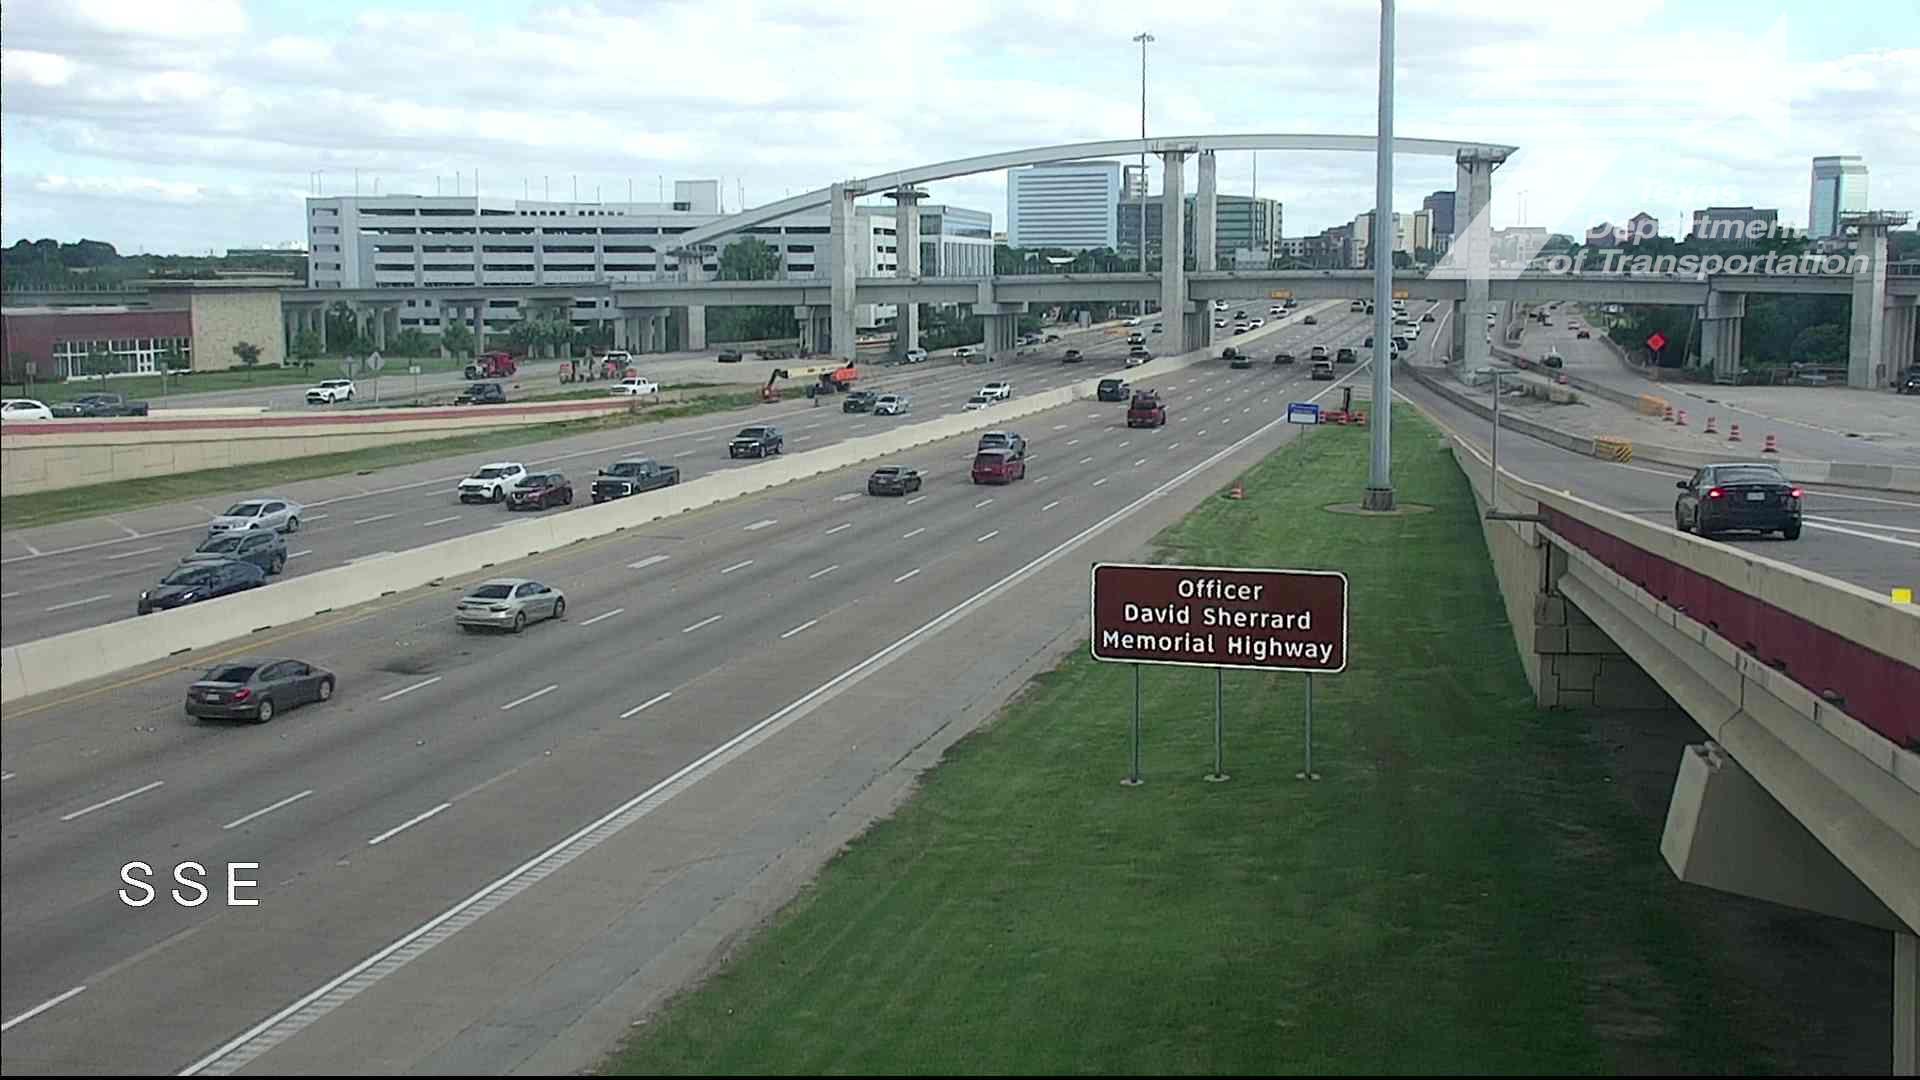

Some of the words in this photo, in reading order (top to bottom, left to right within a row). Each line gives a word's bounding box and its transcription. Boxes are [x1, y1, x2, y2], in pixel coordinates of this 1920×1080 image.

[1178, 579, 1263, 601] Officer
[1124, 604, 1191, 625] David
[1203, 608, 1312, 631] Sherrard
[1103, 631, 1215, 654] Memorial
[1228, 636, 1334, 664] Highway
